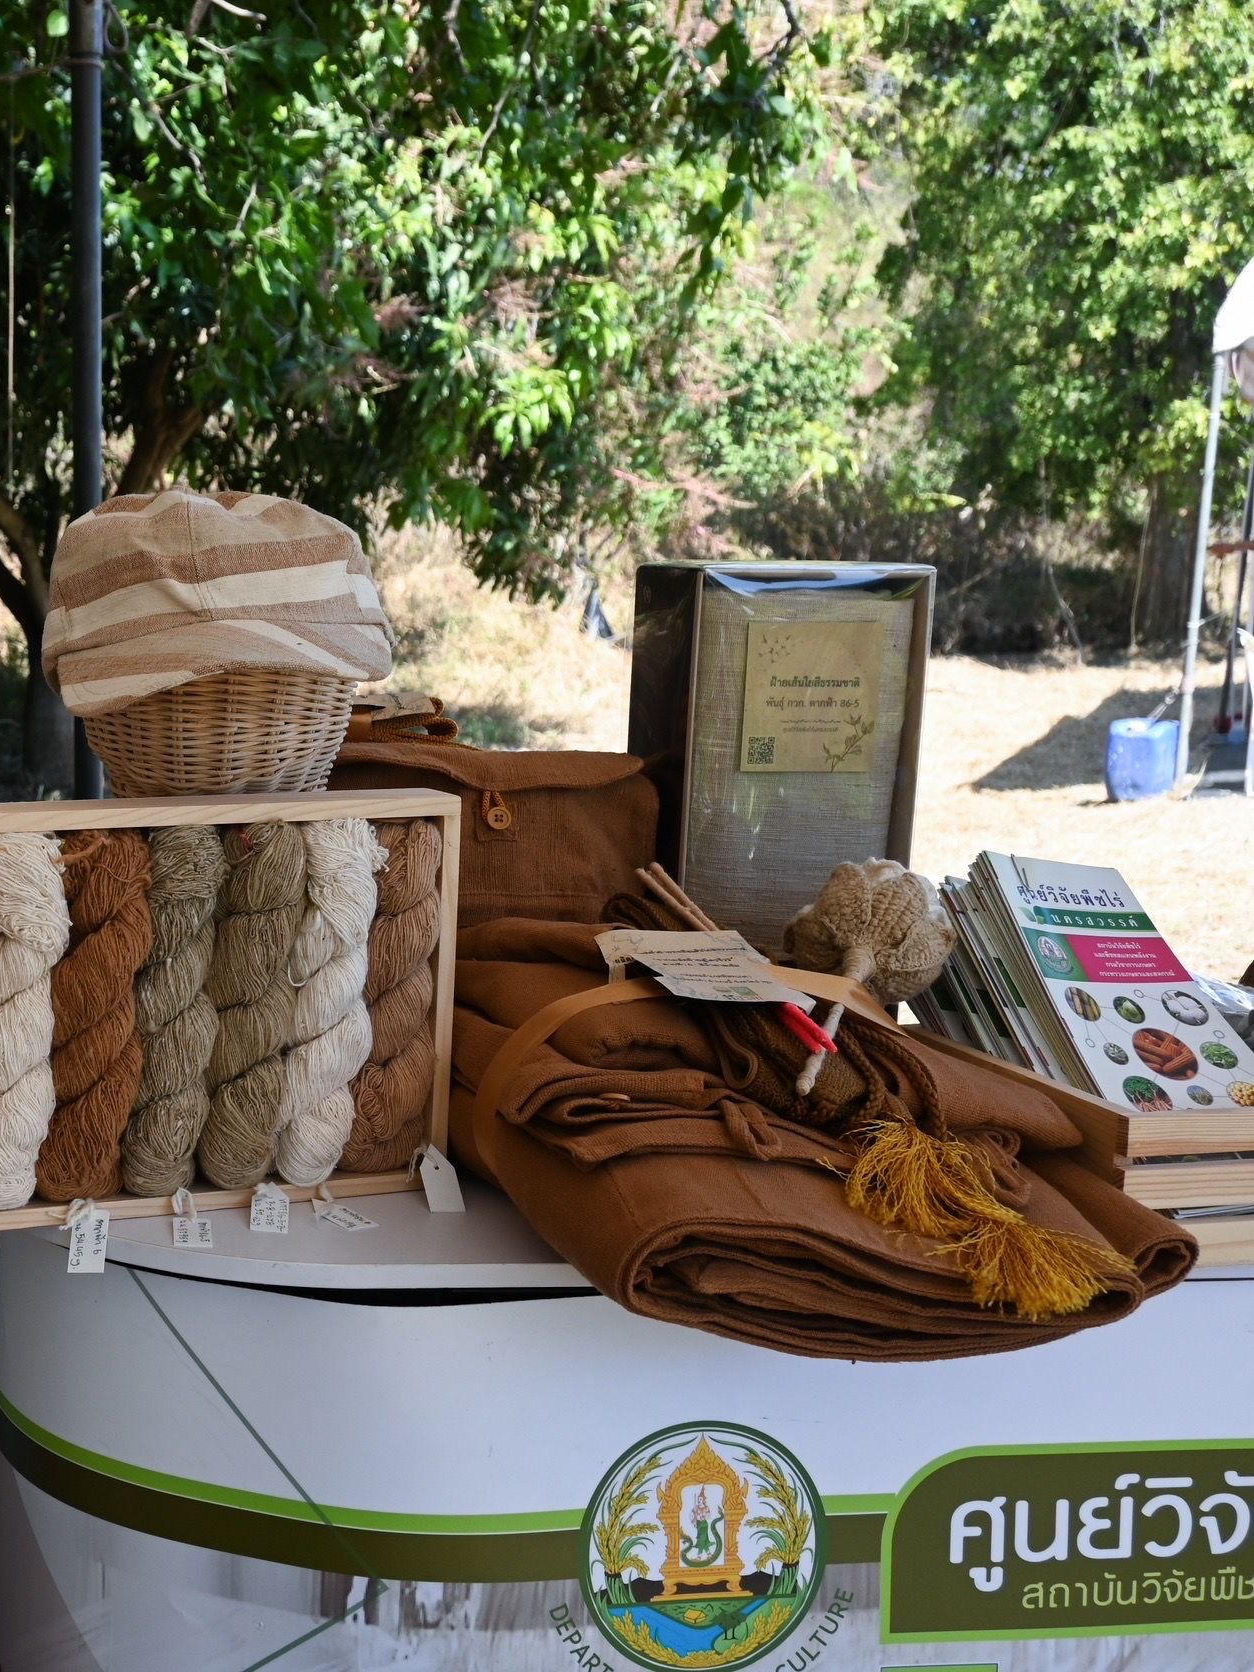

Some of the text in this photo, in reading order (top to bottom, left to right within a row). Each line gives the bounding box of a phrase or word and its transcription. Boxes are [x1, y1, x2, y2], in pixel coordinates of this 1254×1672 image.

[840, 699, 860, 708] 86-5
[1017, 884, 1125, 908] ศูนย์วิจัยพืชไร่
